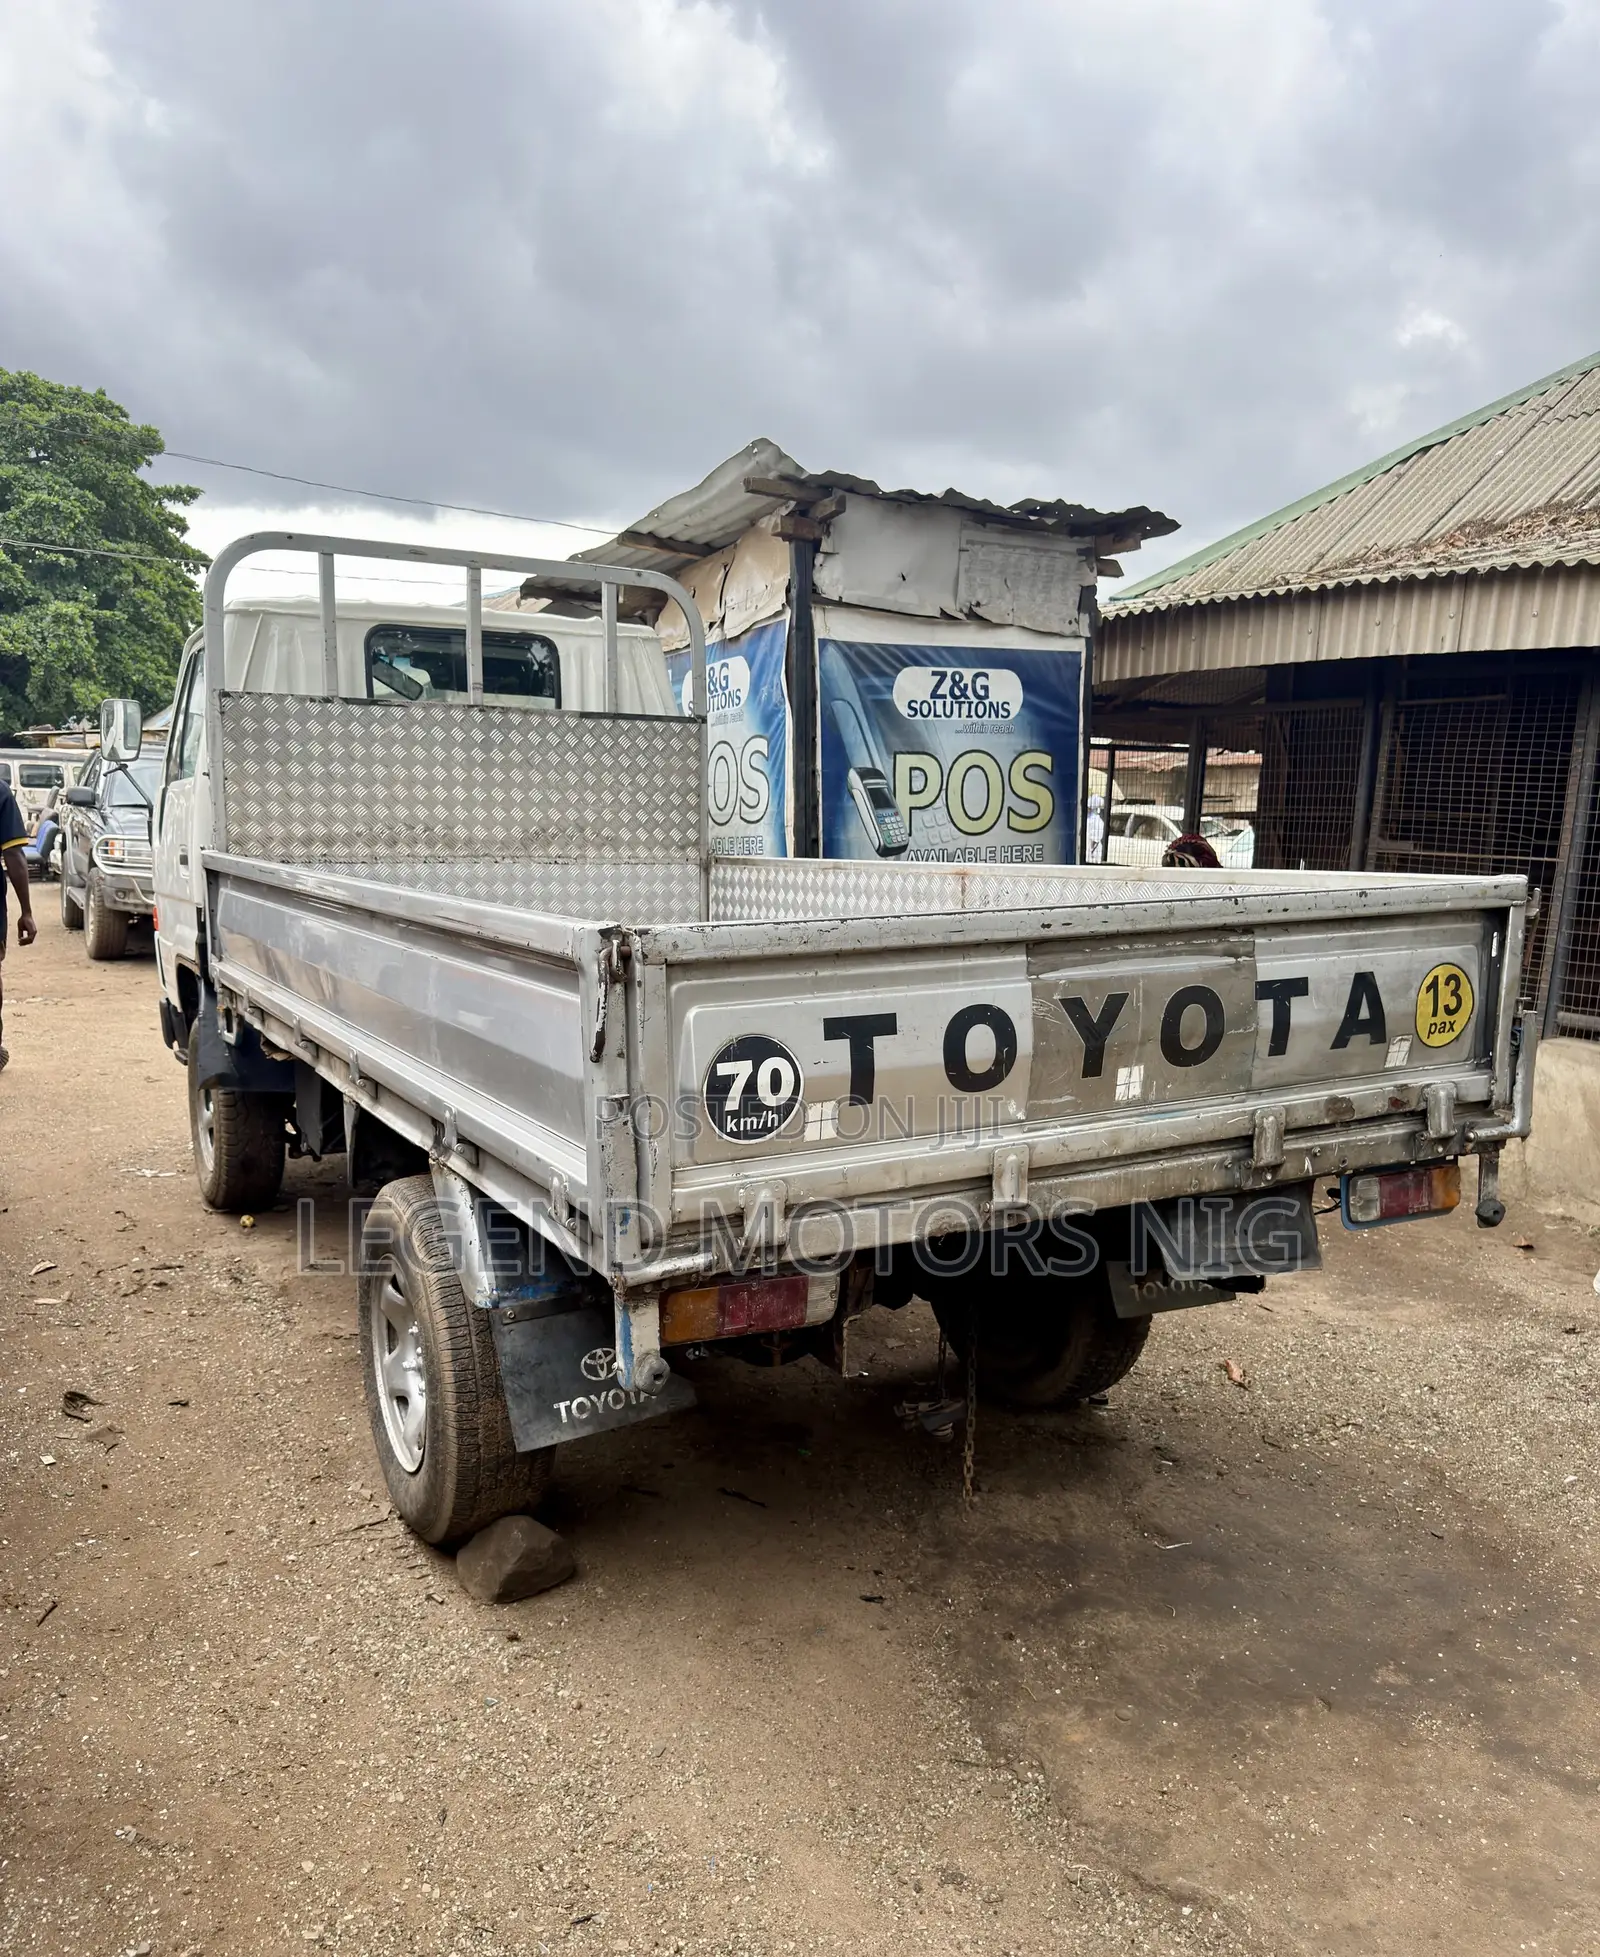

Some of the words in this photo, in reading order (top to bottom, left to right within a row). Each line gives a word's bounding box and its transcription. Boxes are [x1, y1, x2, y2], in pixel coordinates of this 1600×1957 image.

[707, 662, 729, 695] &G
[929, 670, 990, 700] Z&G
[907, 700, 1011, 719] SOLUTIONS
[990, 723, 1015, 734] reach
[708, 734, 769, 827] OS
[893, 748, 1055, 836] POS
[735, 836, 764, 855] HERE
[907, 846, 997, 863] AVAILABLE
[1000, 844, 1044, 863] HERE
[1425, 973, 1462, 1017] 13
[823, 971, 1387, 1107] TOYOTA
[1427, 1020, 1456, 1039] pax
[716, 1056, 795, 1111] 70
[726, 1110, 779, 1133] km/h
